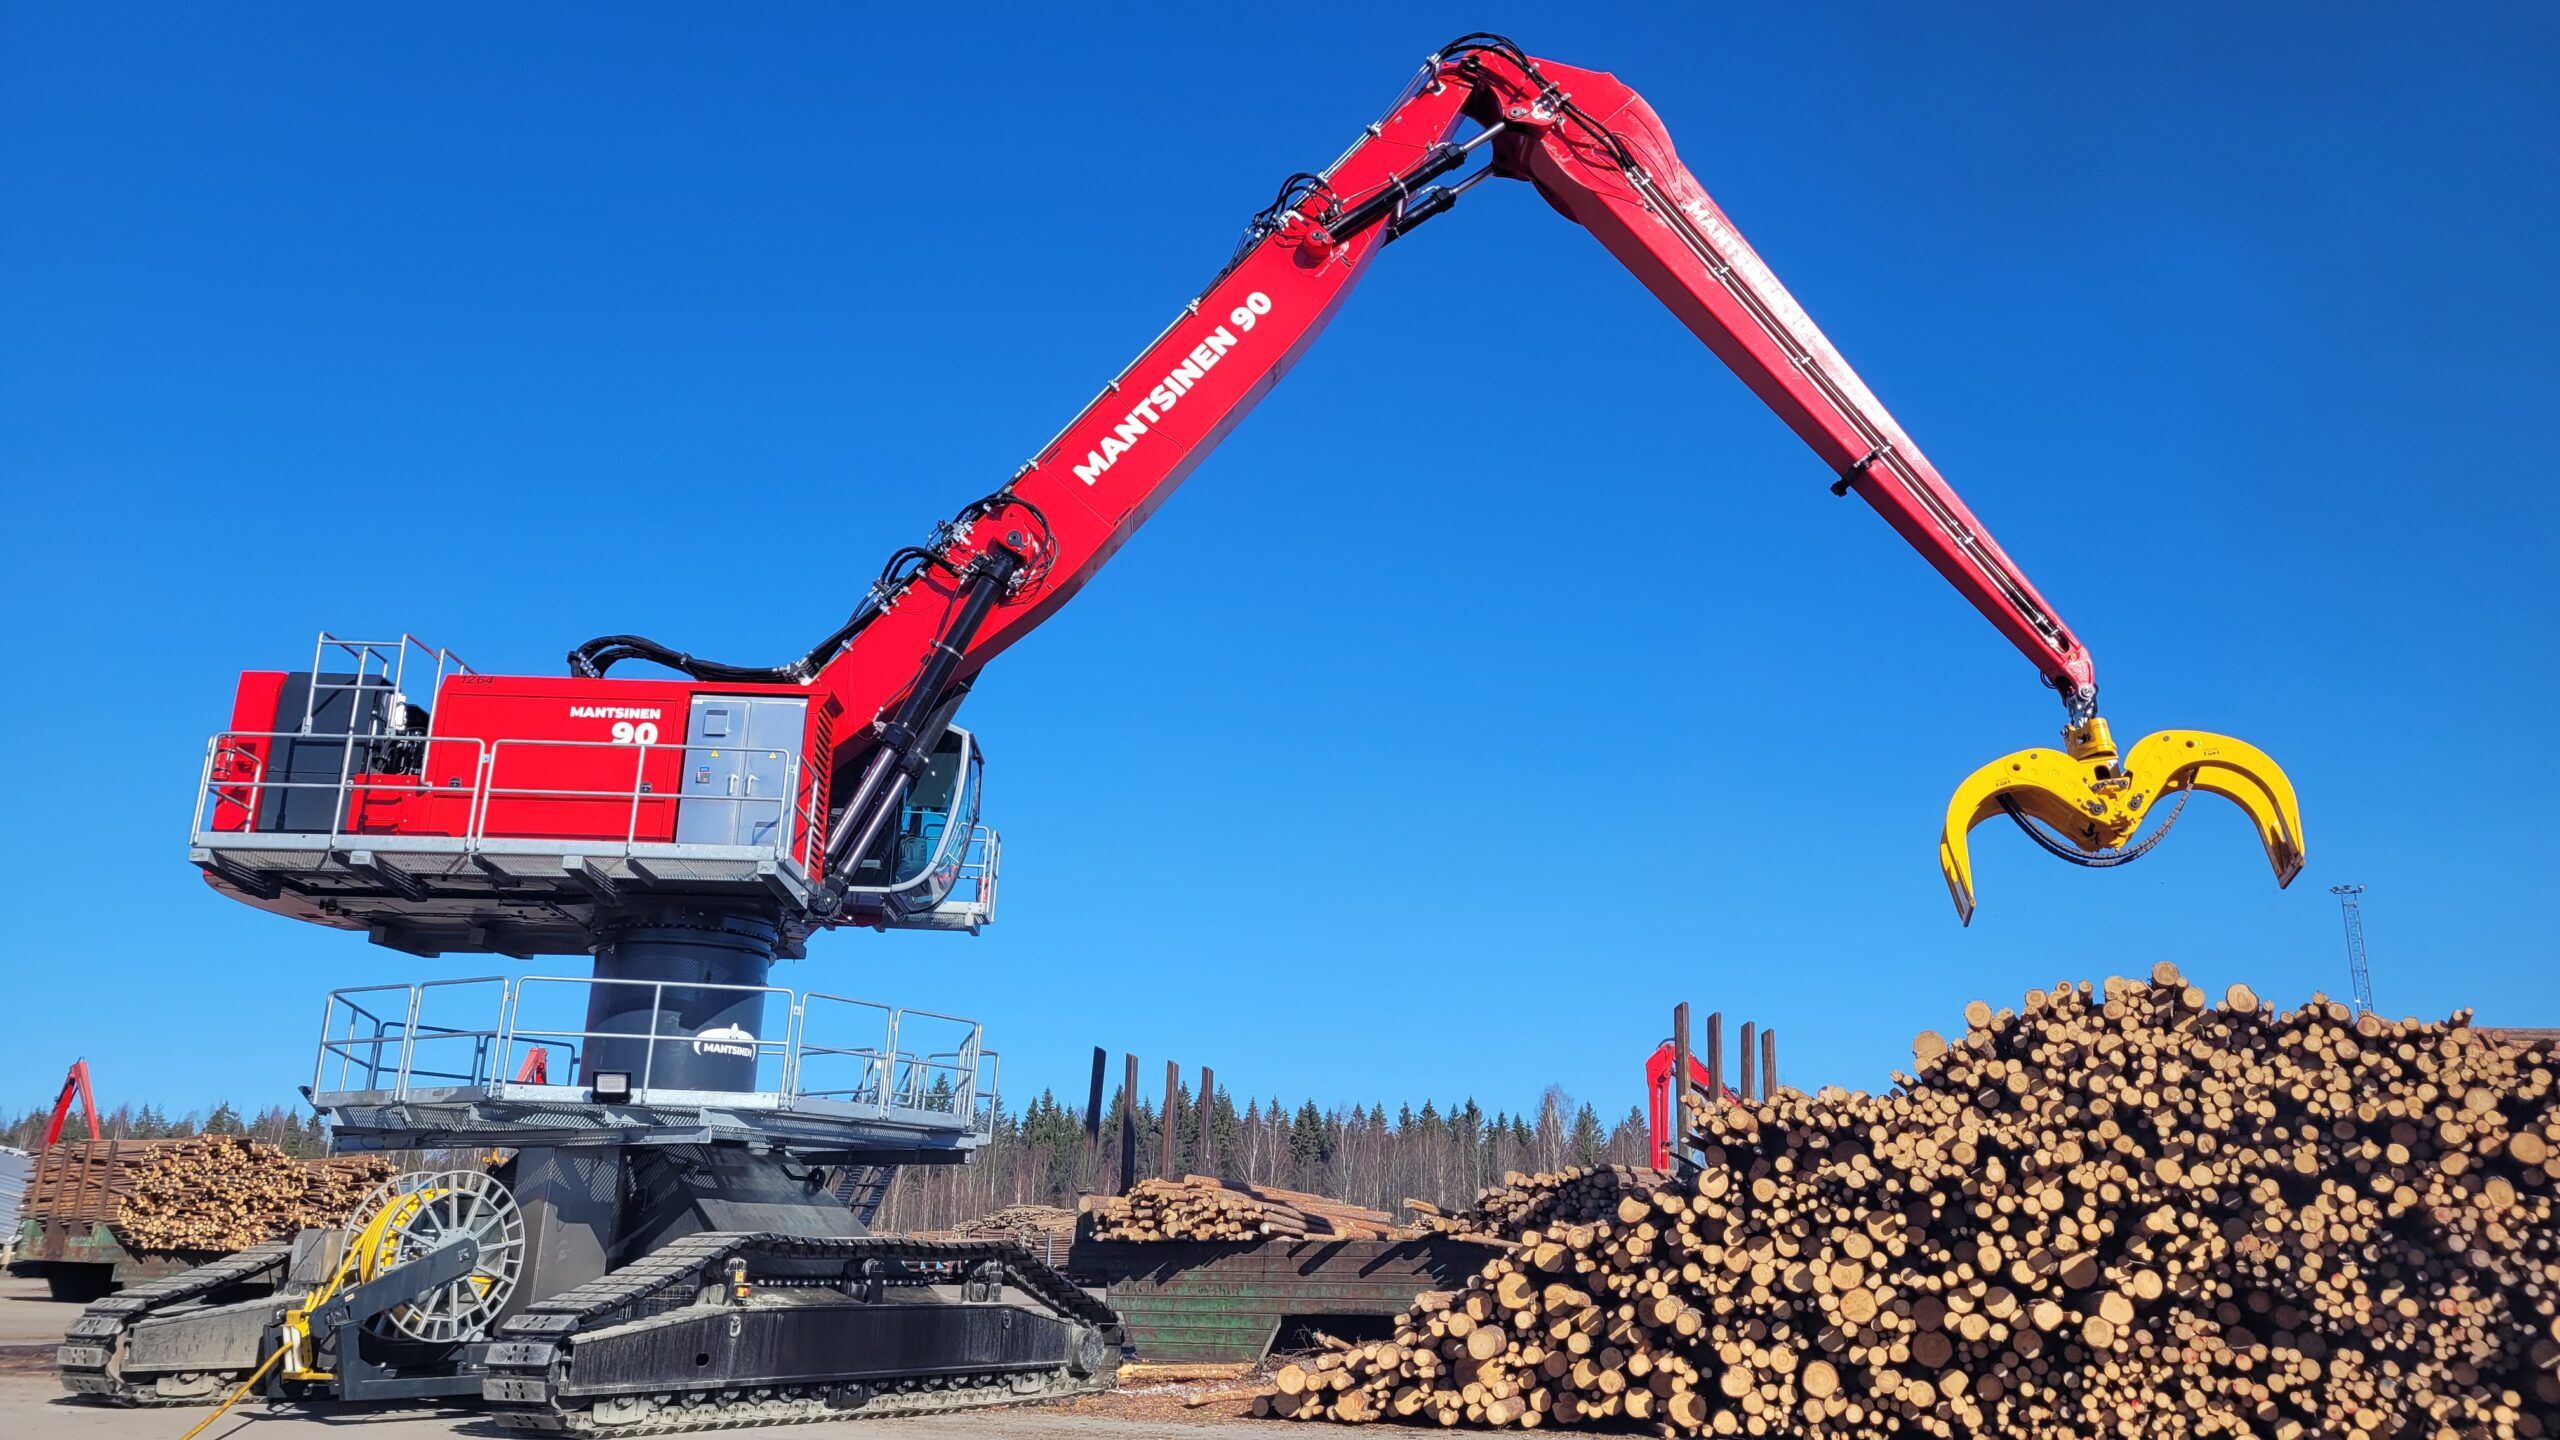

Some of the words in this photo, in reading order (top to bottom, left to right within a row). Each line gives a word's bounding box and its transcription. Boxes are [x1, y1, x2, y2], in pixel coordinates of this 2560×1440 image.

[1685, 199, 1788, 311] MANTSIN
[1072, 325, 1238, 487] MANTSINEN
[1229, 291, 1272, 333] 90
[570, 706, 661, 720] MANTSINEN
[611, 721, 658, 744] 90
[703, 1042, 753, 1058] MANTSINEN
